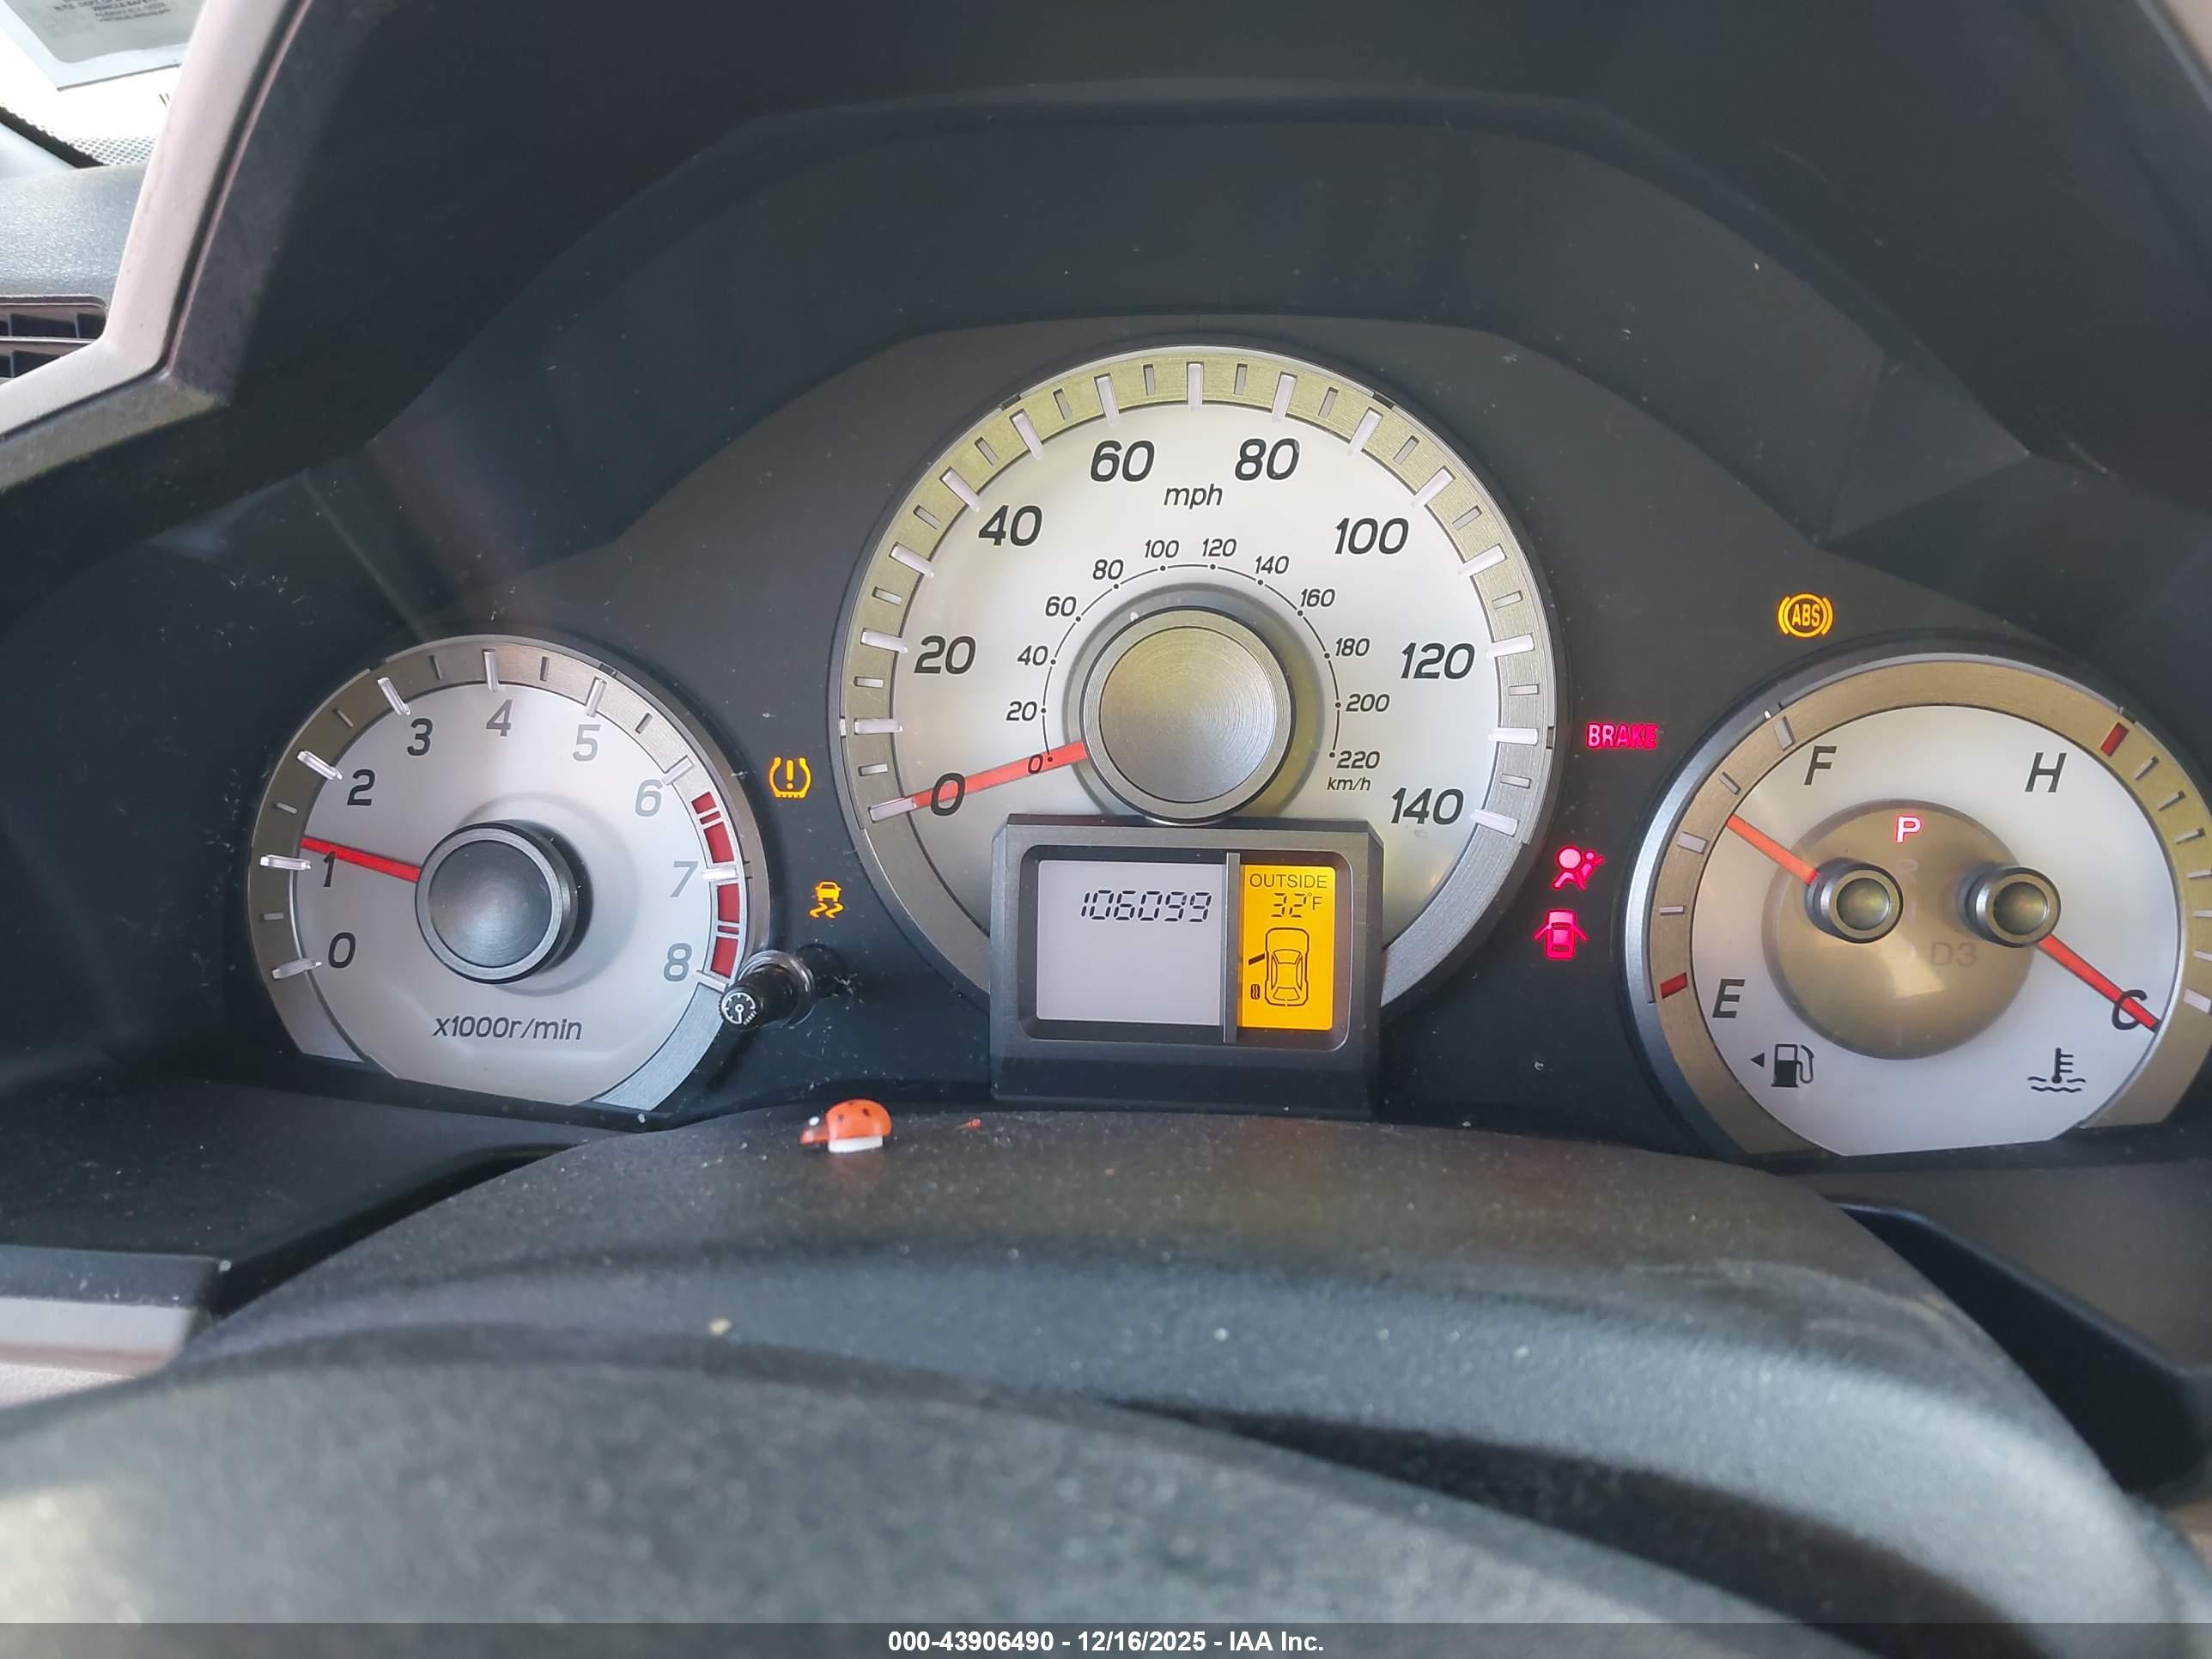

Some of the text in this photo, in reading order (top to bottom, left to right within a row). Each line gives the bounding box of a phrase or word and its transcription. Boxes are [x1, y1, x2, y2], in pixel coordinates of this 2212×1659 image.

[1090, 440, 1155, 483] 60
[1235, 438, 1300, 480] 80
[1164, 483, 1223, 509] mph
[978, 505, 1042, 546] 40
[1335, 517, 1409, 555] 100
[1144, 540, 1180, 558] 100
[1202, 538, 1237, 557] 120
[1255, 556, 1290, 574] 140
[1092, 560, 1123, 580] 80
[1045, 596, 1076, 617] 60
[1300, 588, 1335, 608] 160
[1791, 604, 1821, 627] ABS
[915, 635, 976, 675] 20
[1017, 645, 1048, 666] 40
[1335, 638, 1370, 657] 180
[1401, 642, 1475, 680] 120
[487, 700, 514, 737] 4
[1006, 701, 1037, 721] 20
[1346, 694, 1390, 713] 200
[407, 719, 434, 757] 3
[573, 725, 599, 761] 5
[1588, 724, 1657, 748] BRAKE
[1028, 754, 1045, 775] 0
[1337, 750, 1381, 769] 220
[1804, 746, 1837, 785] F
[2026, 752, 2066, 793] H
[348, 769, 375, 807] 2
[635, 779, 663, 817] 6
[931, 773, 965, 815] 0
[1327, 776, 1371, 792] km/h
[1390, 787, 1465, 825] 140
[1895, 816, 1922, 843] P
[323, 852, 337, 887] 1
[671, 861, 699, 898] 7
[1249, 873, 1328, 888] OUTSIDE
[1080, 890, 1212, 922] 106099
[328, 932, 356, 969] 0
[664, 944, 692, 981] 8
[1713, 979, 1745, 1018] E
[2112, 990, 2147, 1030] C
